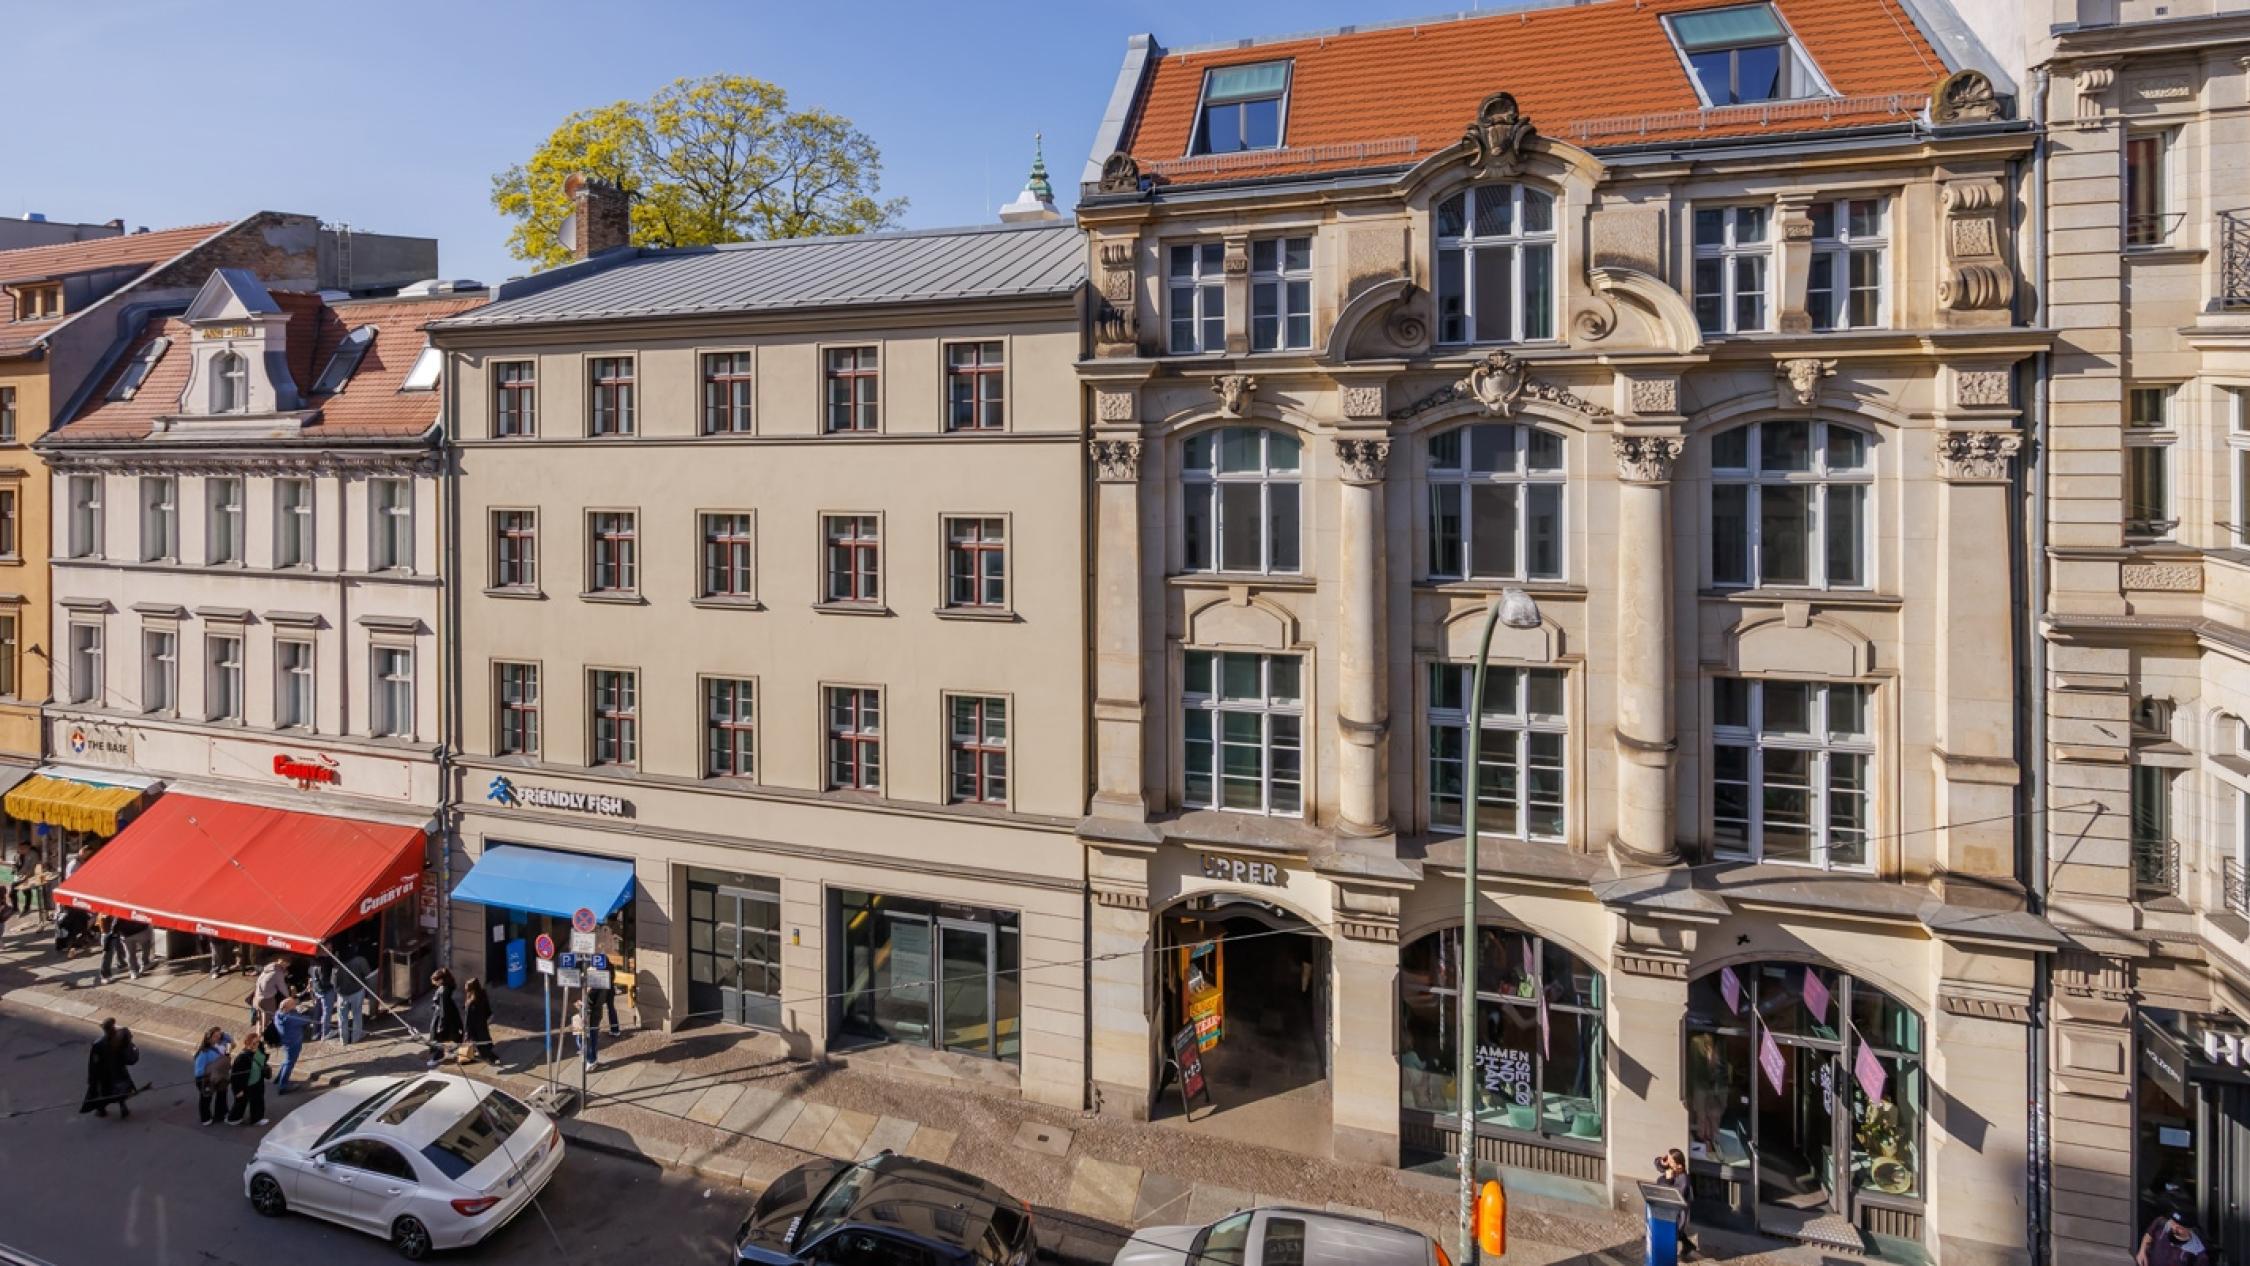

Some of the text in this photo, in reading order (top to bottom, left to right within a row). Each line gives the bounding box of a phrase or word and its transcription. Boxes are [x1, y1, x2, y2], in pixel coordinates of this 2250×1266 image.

[87, 740, 128, 754] THE BASE
[1476, 1045, 1530, 1062] AMMEN
[2204, 1031, 2250, 1069] H
